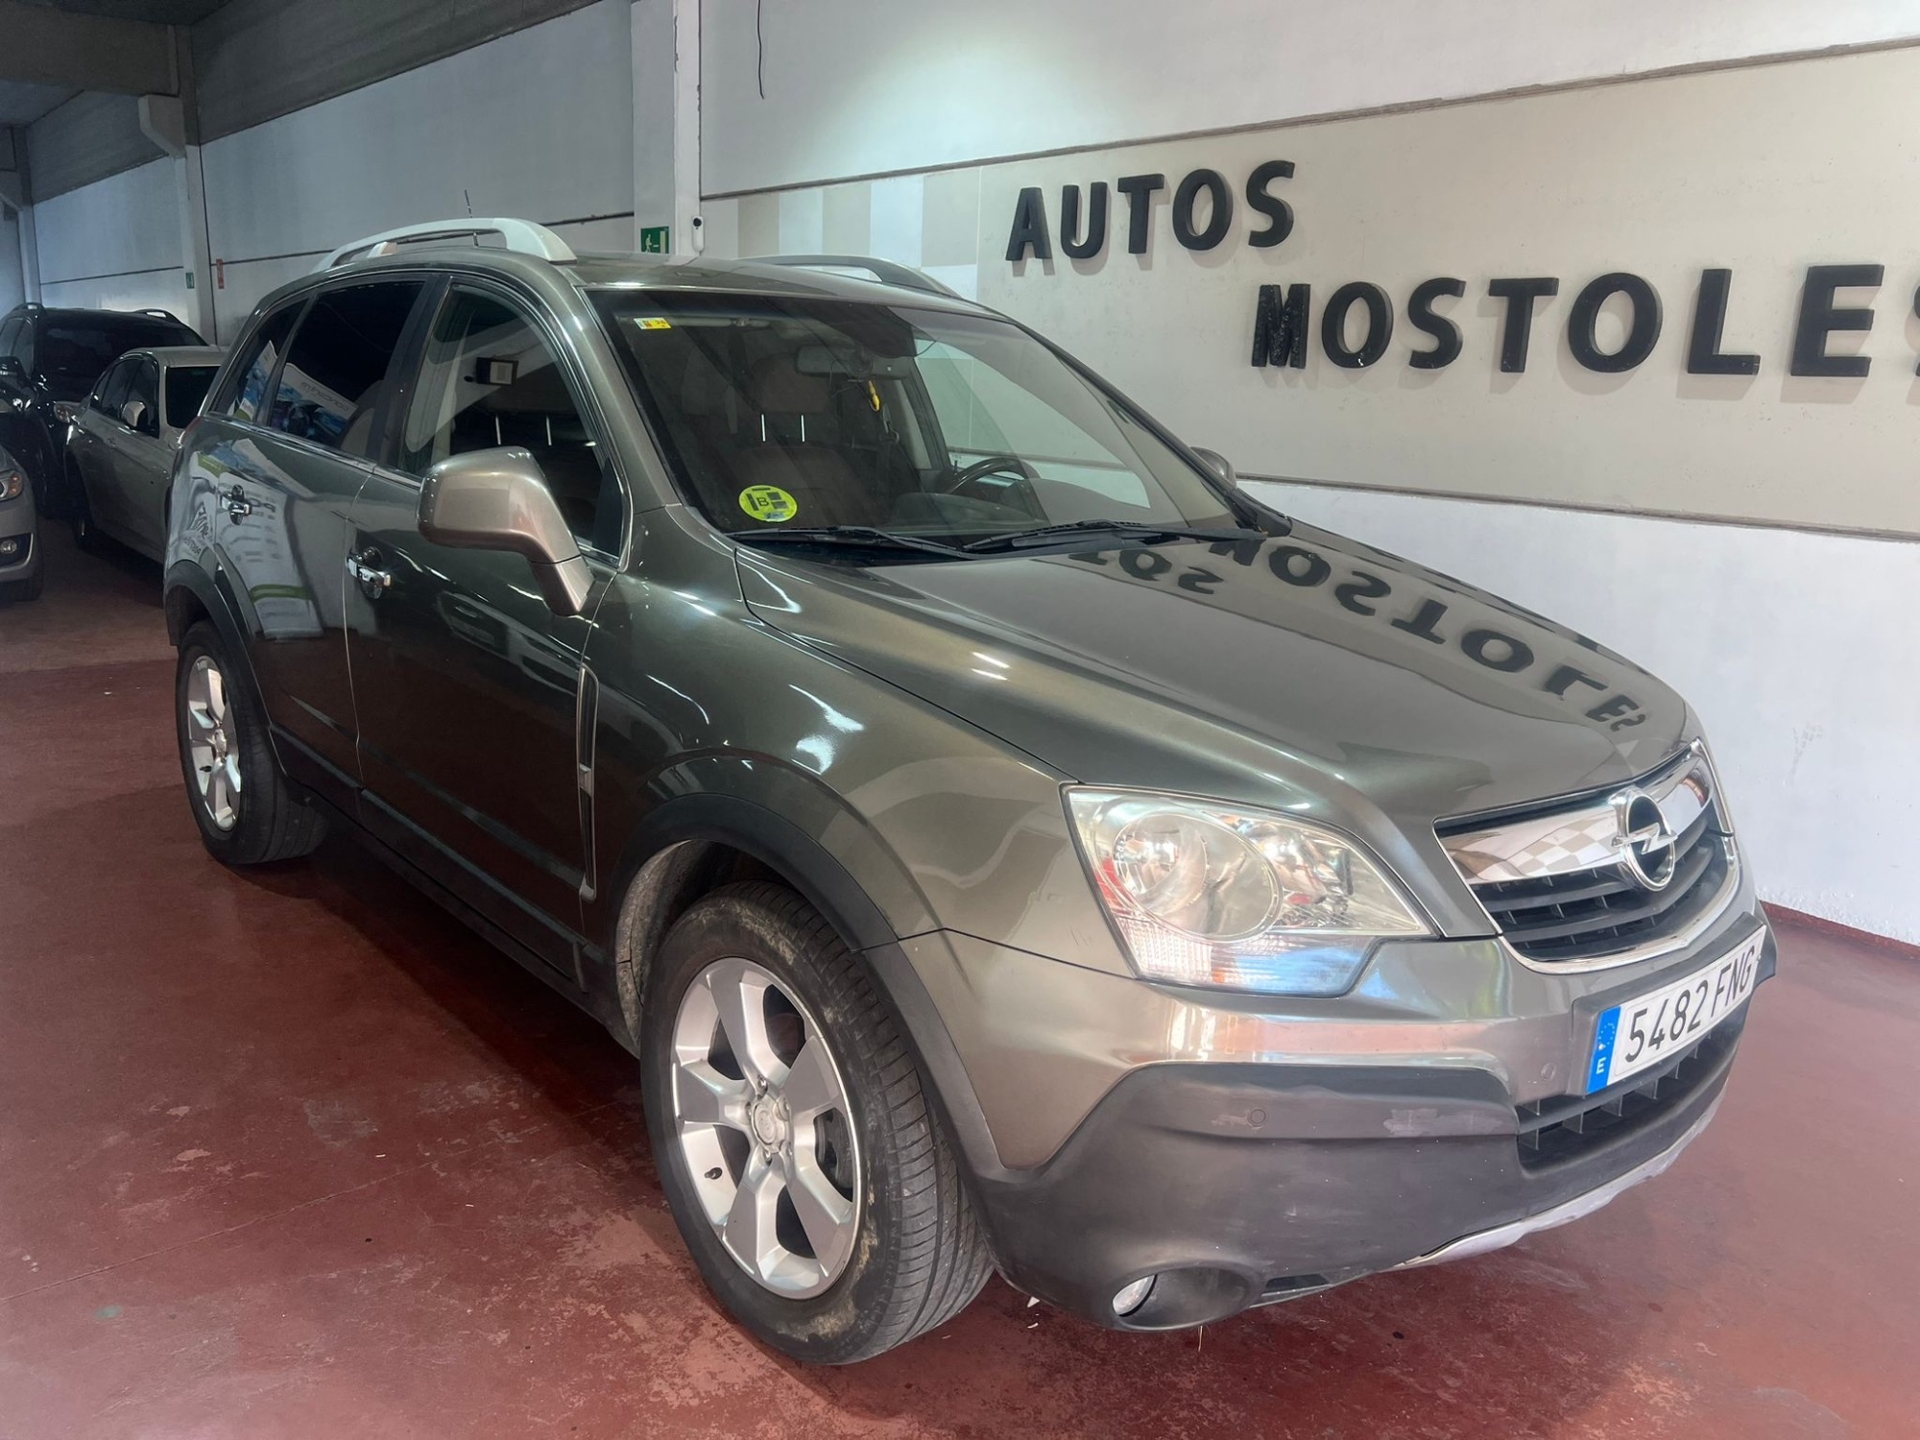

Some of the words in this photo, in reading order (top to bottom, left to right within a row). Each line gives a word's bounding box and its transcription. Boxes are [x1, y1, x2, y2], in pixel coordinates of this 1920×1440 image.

[1005, 160, 1295, 262] AUTOS
[1251, 263, 1920, 377] MOSTOLE
[756, 497, 769, 507] B
[1624, 979, 1709, 1063] 5482
[1711, 945, 1756, 1018] FNG
[1595, 1057, 1607, 1075] E
